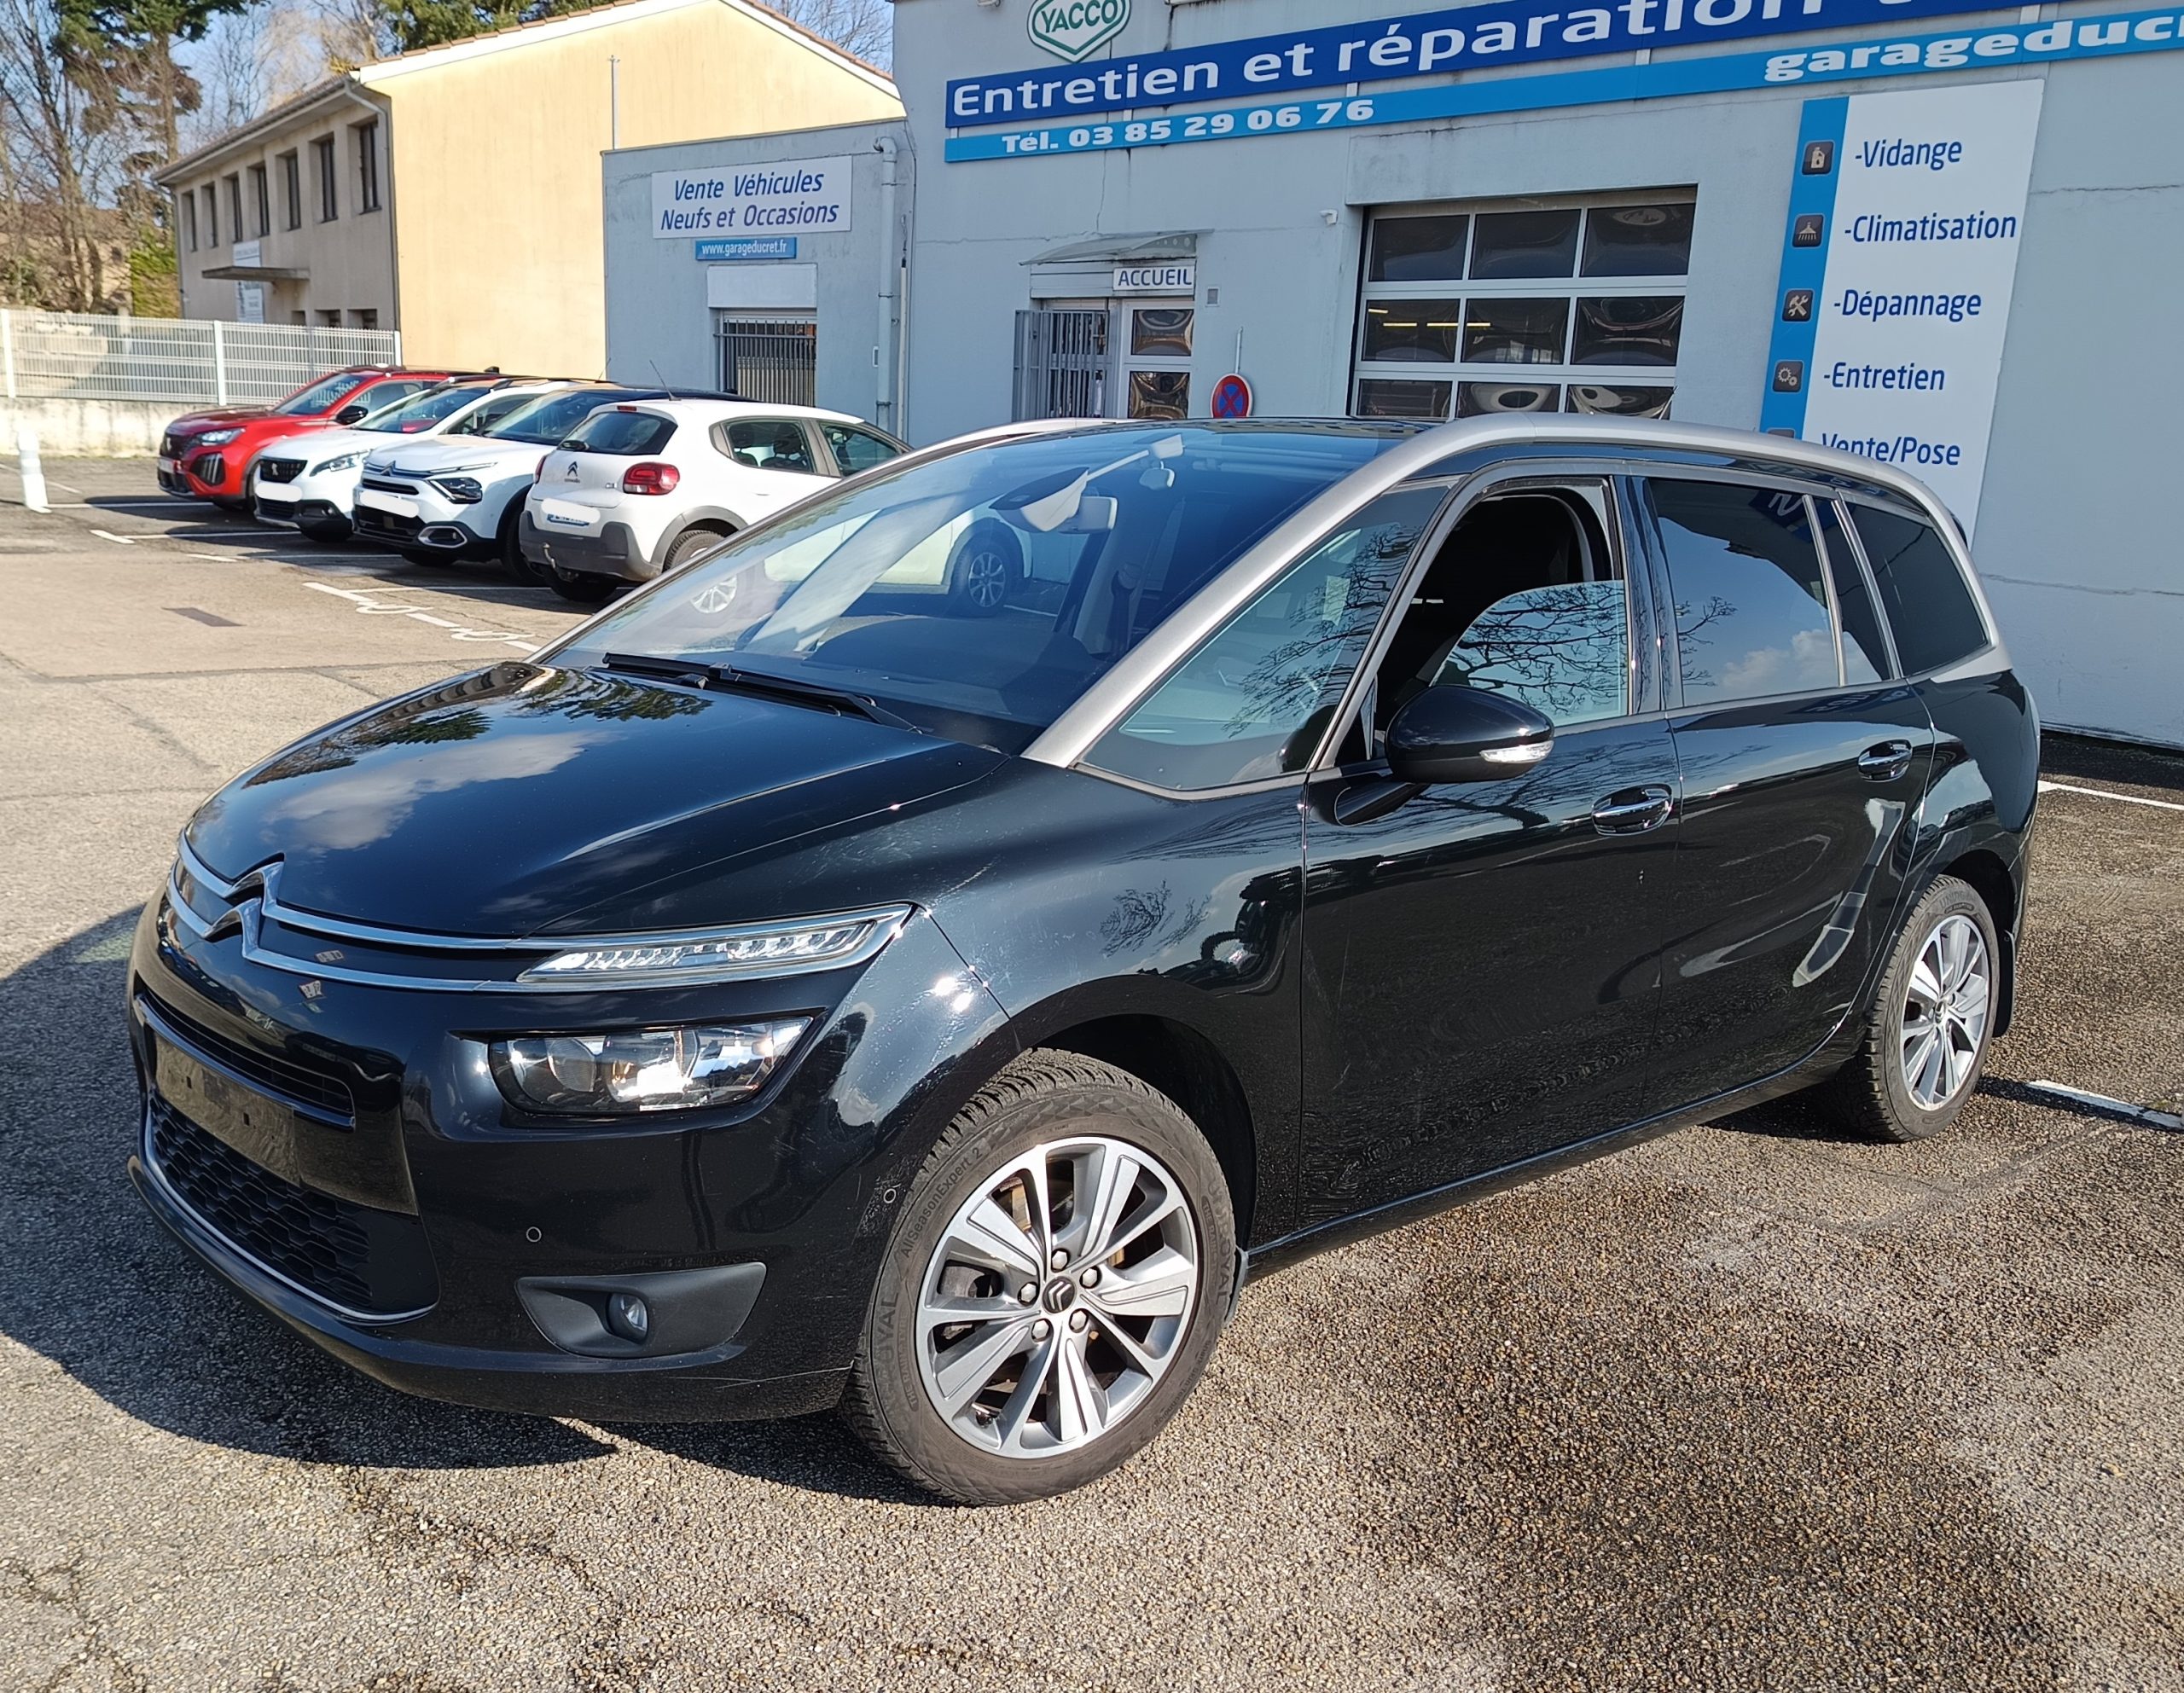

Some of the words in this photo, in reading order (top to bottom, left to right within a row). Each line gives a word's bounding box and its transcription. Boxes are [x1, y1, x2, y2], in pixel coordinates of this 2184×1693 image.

[1041, 0, 1118, 33] YACCO
[1764, 14, 2184, 82] garageduc
[953, 61, 1219, 116] Entretien
[1243, 42, 1314, 83] et
[1002, 131, 1059, 154] Tél.
[1069, 126, 1113, 148] 03
[1124, 120, 1171, 143] 85
[1184, 113, 1234, 136] 29
[1247, 106, 1301, 130] 06
[1316, 99, 1374, 125] 76
[1855, 138, 1962, 171] -Vidange
[675, 178, 724, 201] Vente
[735, 169, 824, 197] Véhicules
[661, 207, 712, 230] Neufs
[717, 207, 735, 228] et
[744, 201, 839, 227] Occasions
[1844, 212, 2017, 243] -Climatisation
[702, 241, 787, 256] www.garageducret.fr
[1118, 269, 1192, 286] ACCUEIL
[1833, 289, 1982, 323] -Dépannage
[1823, 362, 1946, 391] -Entretien
[901, 1158, 972, 1258] AllSeasonExpert
[973, 1147, 983, 1160] 2
[905, 1385, 918, 1406] THE
